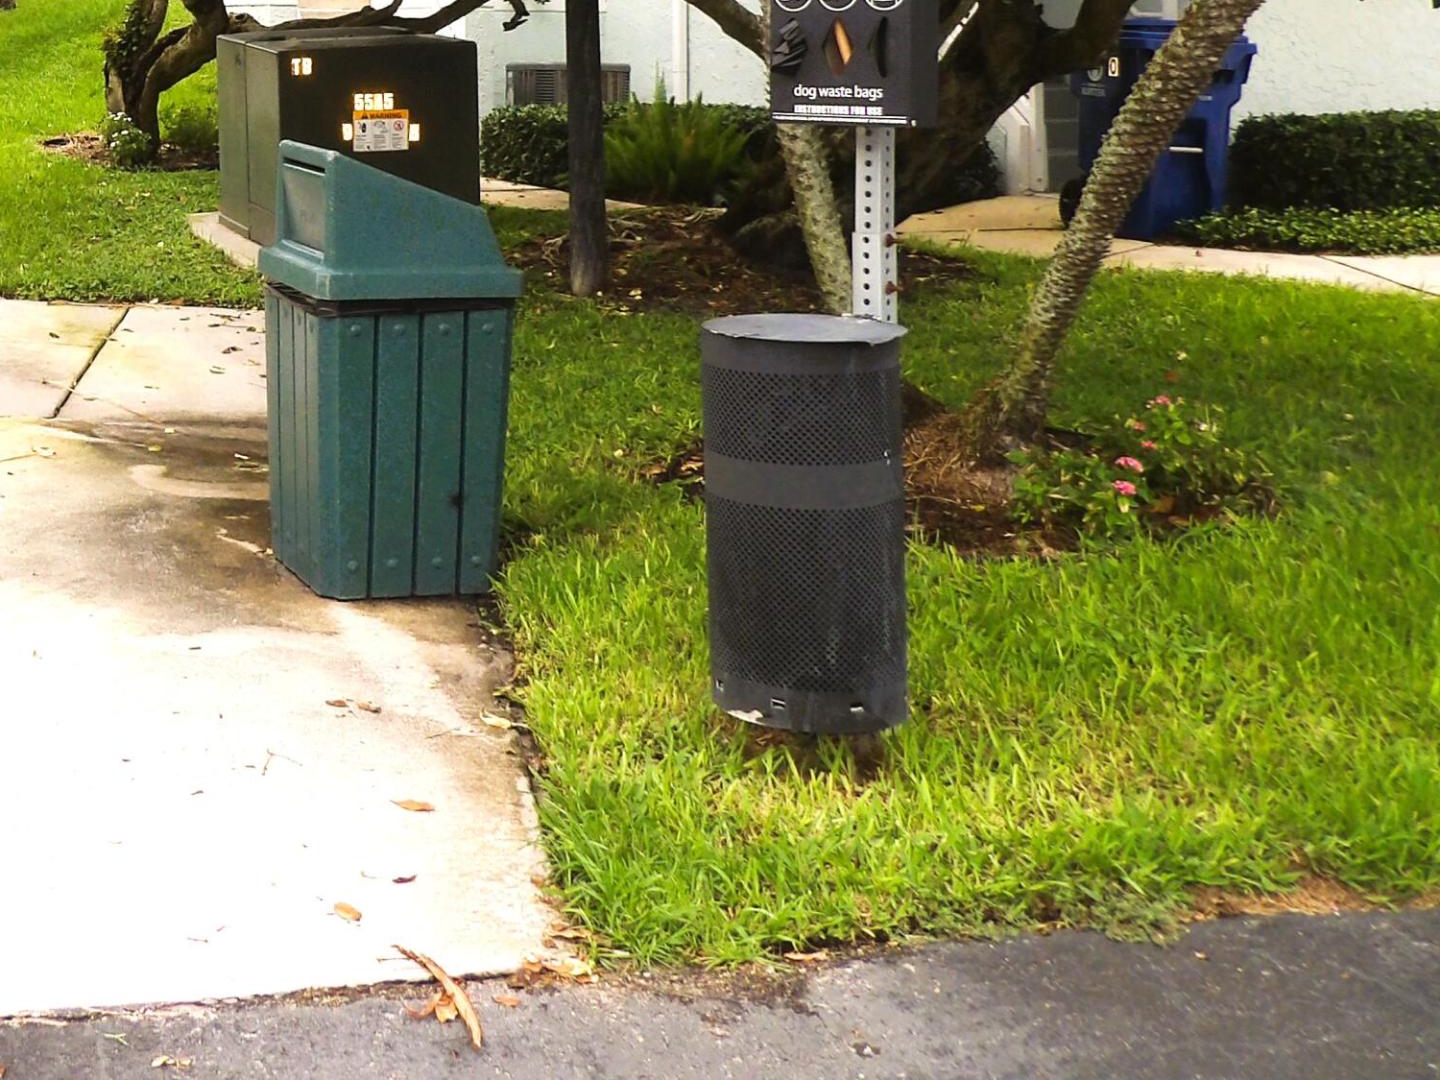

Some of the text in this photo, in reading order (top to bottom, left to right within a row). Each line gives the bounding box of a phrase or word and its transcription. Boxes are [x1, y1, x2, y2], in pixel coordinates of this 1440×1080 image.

[793, 83, 884, 102] dog waste bags
